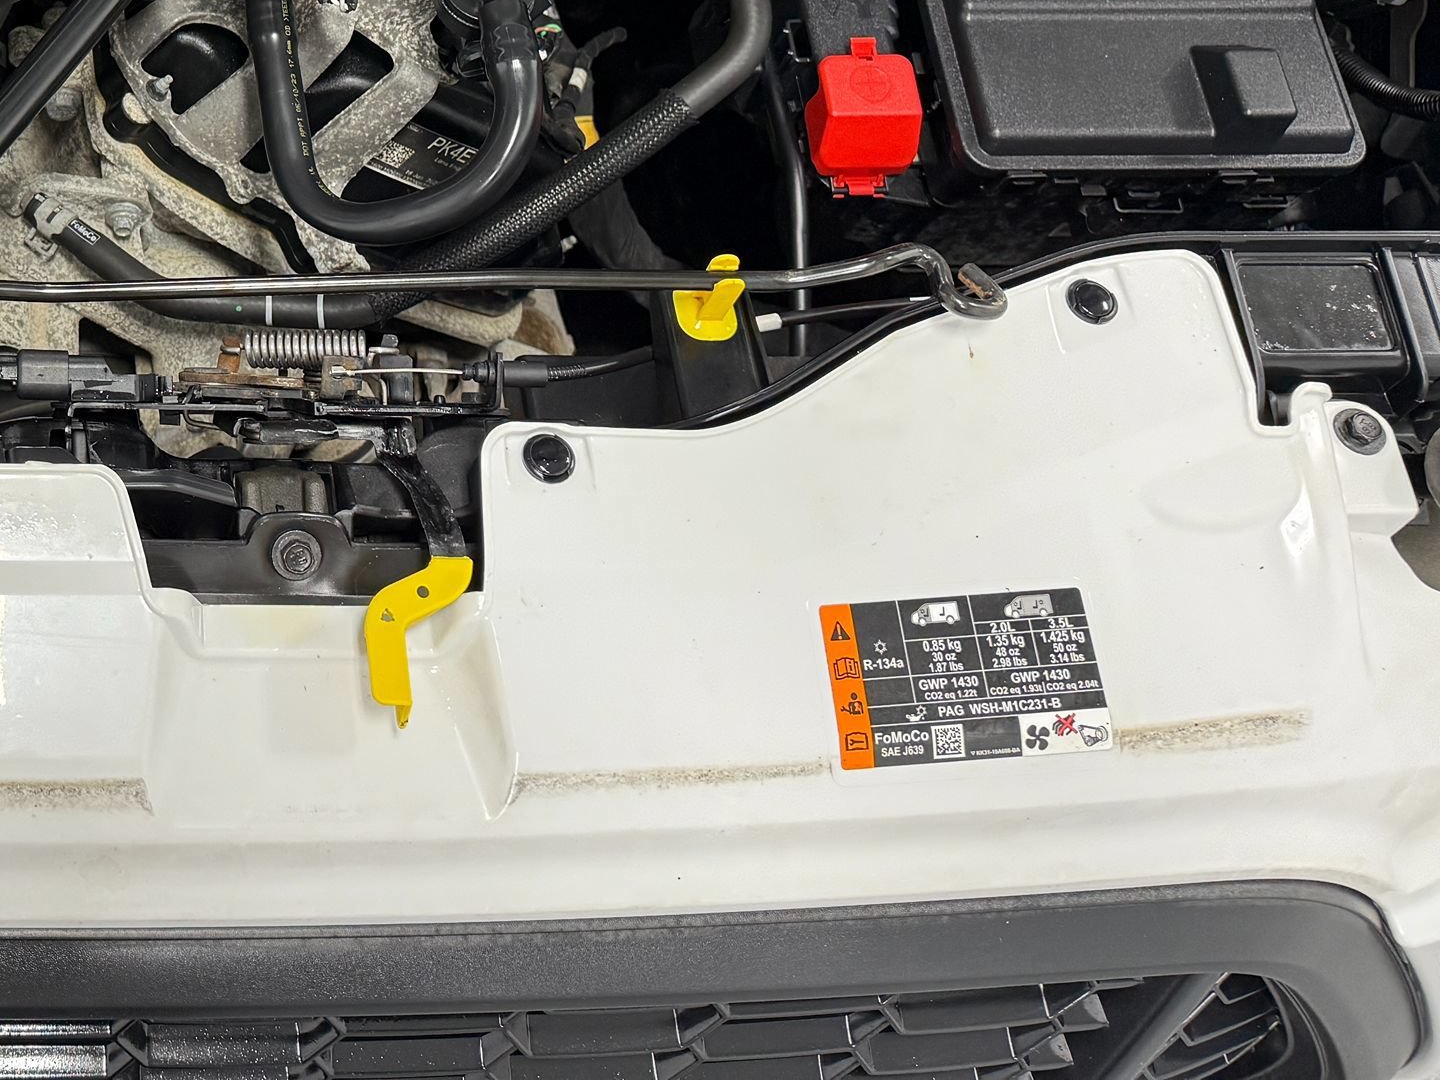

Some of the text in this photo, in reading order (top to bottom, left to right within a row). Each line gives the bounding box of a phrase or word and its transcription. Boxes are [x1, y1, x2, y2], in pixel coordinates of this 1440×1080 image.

[70, 220, 97, 241] FoMoCo
[990, 621, 1016, 633] 2.0L
[1048, 617, 1074, 629] 3.5L
[986, 634, 1025, 648] 1.35 kg
[1040, 630, 1085, 643] 1.425 kg
[923, 638, 962, 652] 0.85 kg
[1053, 643, 1064, 652] 50
[932, 652, 943, 662] 30
[996, 648, 1020, 657] 48 oz
[1050, 653, 1085, 663] 3.14 lbs
[863, 657, 905, 671] R-134a
[928, 662, 964, 673] 1.87 lbs
[992, 657, 1028, 668] 2.98 lbs
[1011, 668, 1071, 684] GWP 1430
[918, 675, 979, 691] GWP 1430
[1046, 680, 1099, 691] CO2 eq 2.04t
[925, 689, 978, 700] CO2 eq 1.22t
[990, 684, 1042, 696] CO2 eq 1.93t
[938, 697, 1062, 718] PAG WSH-M1C231-B
[875, 730, 930, 745] FoMoCo
[881, 745, 924, 757] SAE J639
